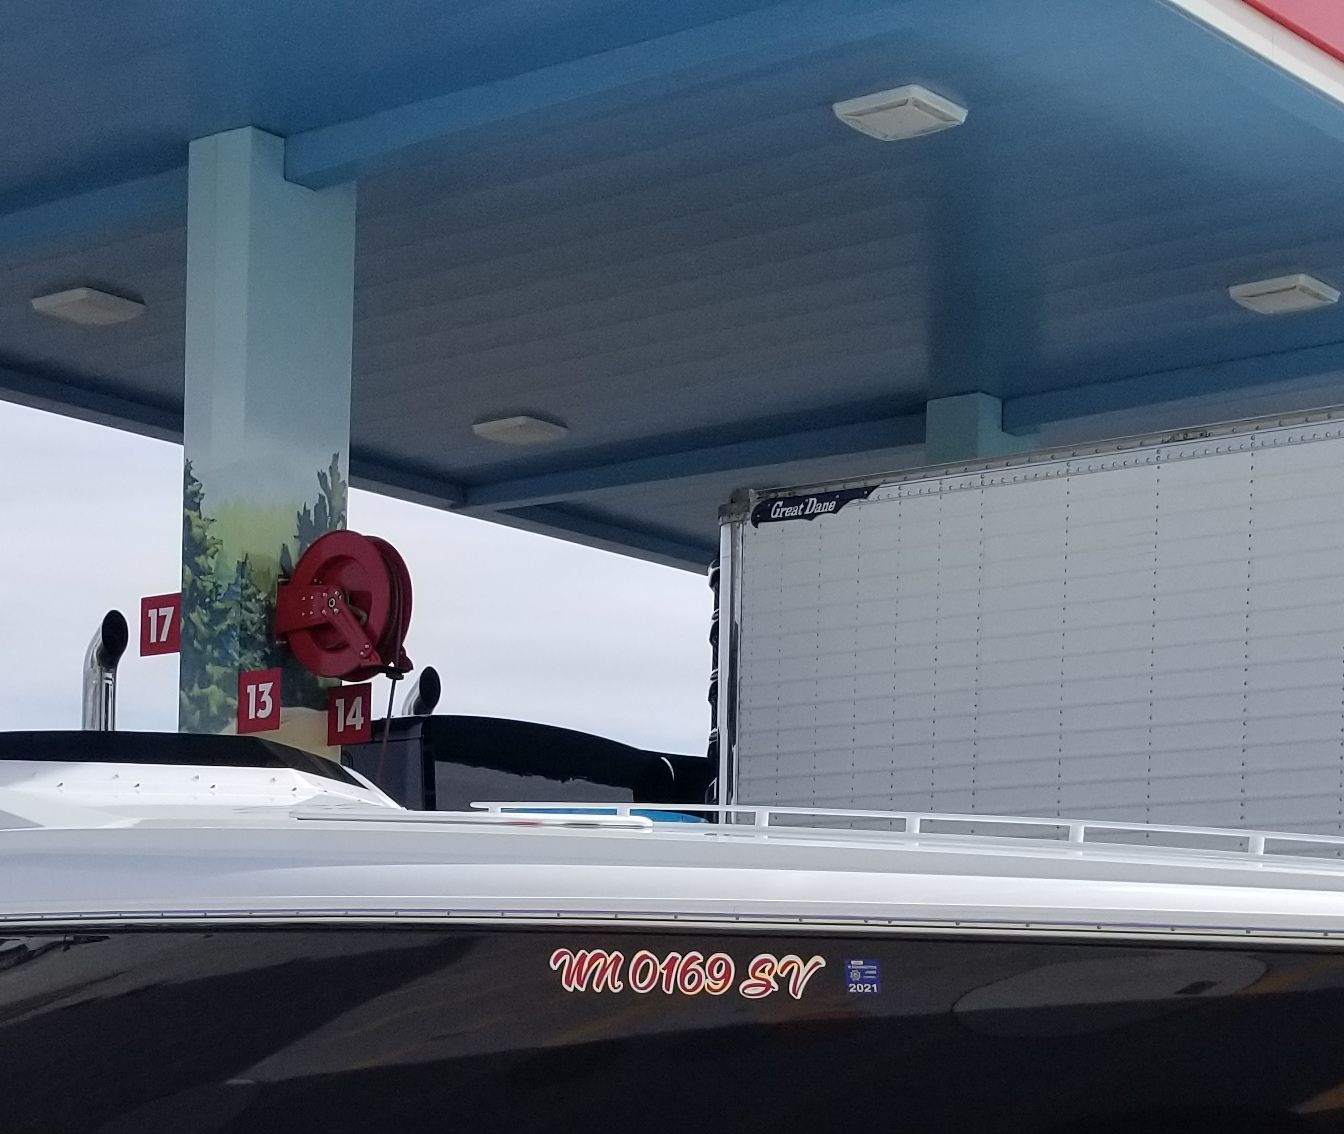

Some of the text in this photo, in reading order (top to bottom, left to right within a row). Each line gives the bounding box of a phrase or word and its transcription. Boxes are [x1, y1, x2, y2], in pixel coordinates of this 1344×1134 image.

[770, 497, 837, 519] Great Dane
[147, 606, 175, 644] 17
[246, 682, 274, 720] 13
[335, 696, 364, 733] 14
[628, 949, 736, 996] 0169
[738, 953, 827, 1000] SV
[848, 983, 878, 993] 2021
